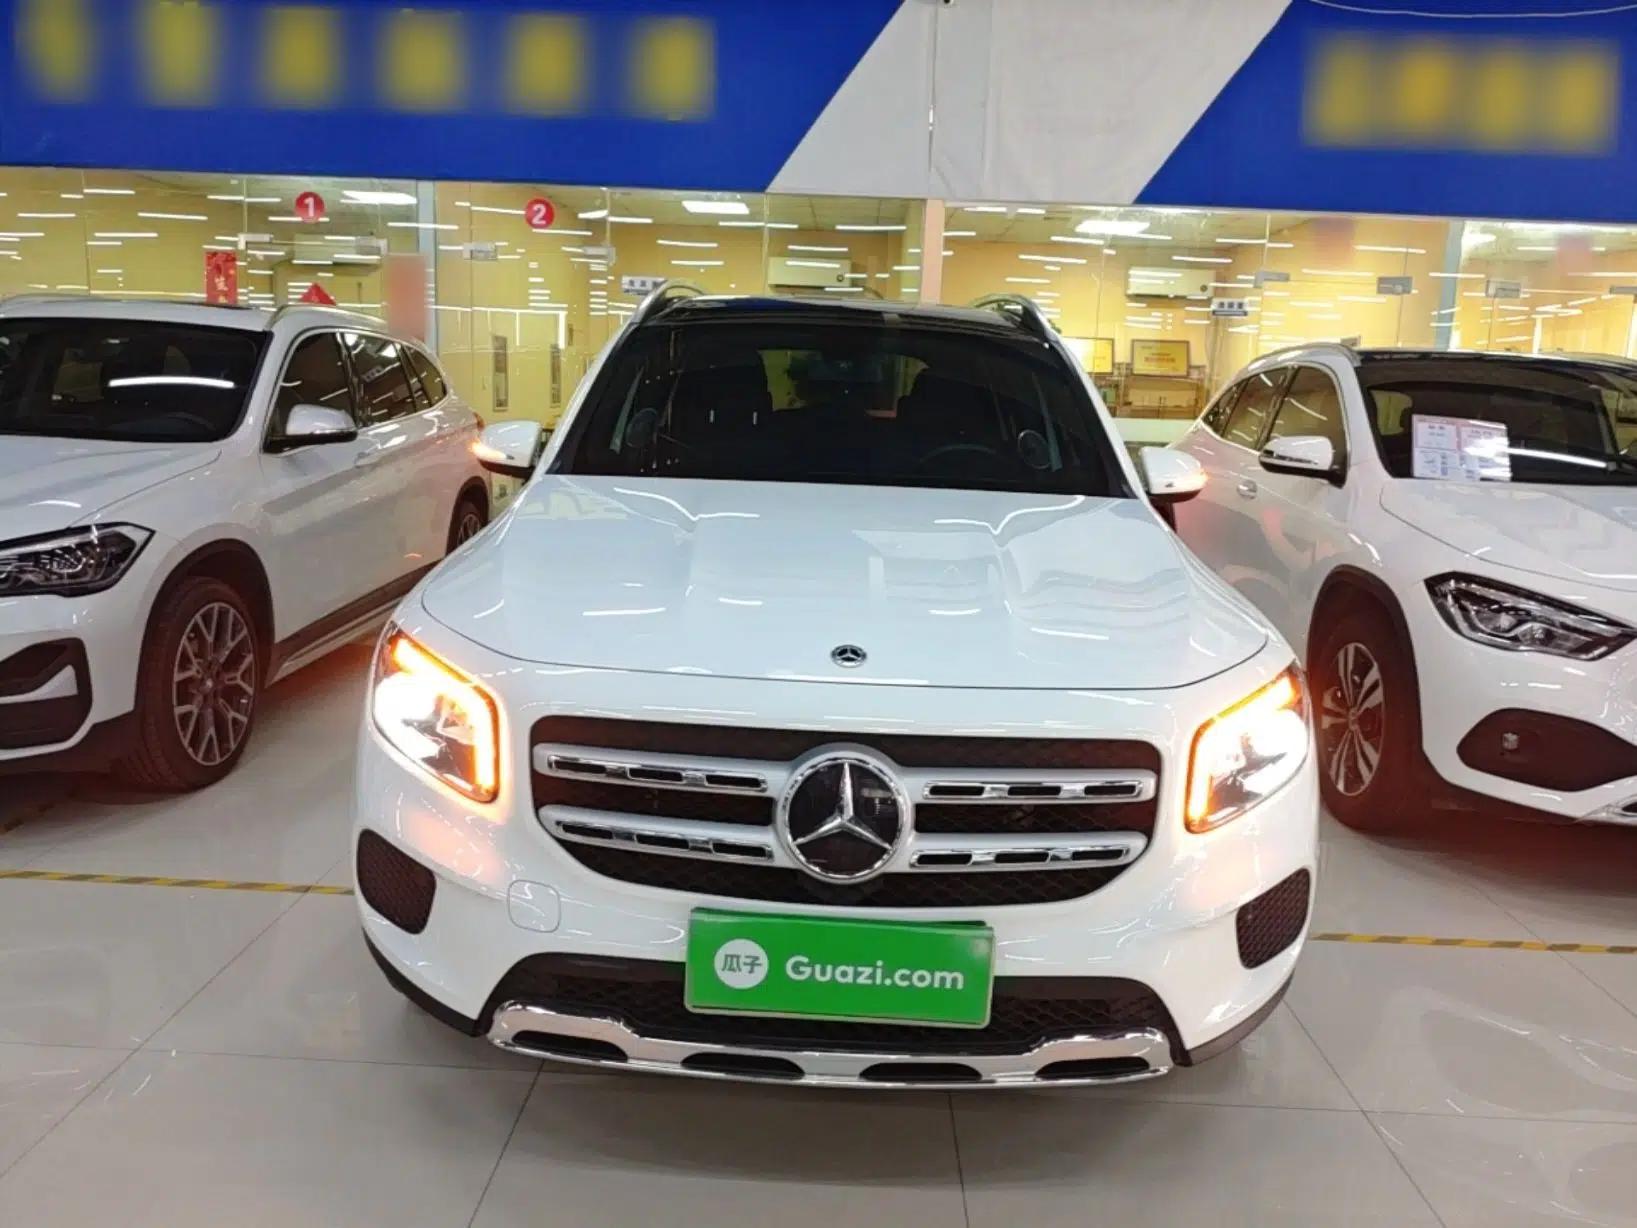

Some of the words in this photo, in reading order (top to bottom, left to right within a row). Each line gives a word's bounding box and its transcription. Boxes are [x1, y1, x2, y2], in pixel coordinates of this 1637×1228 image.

[304, 197, 314, 217] 1
[532, 203, 546, 225] 2
[720, 953, 763, 974] 瓜子
[785, 955, 964, 990] Guazi.com
